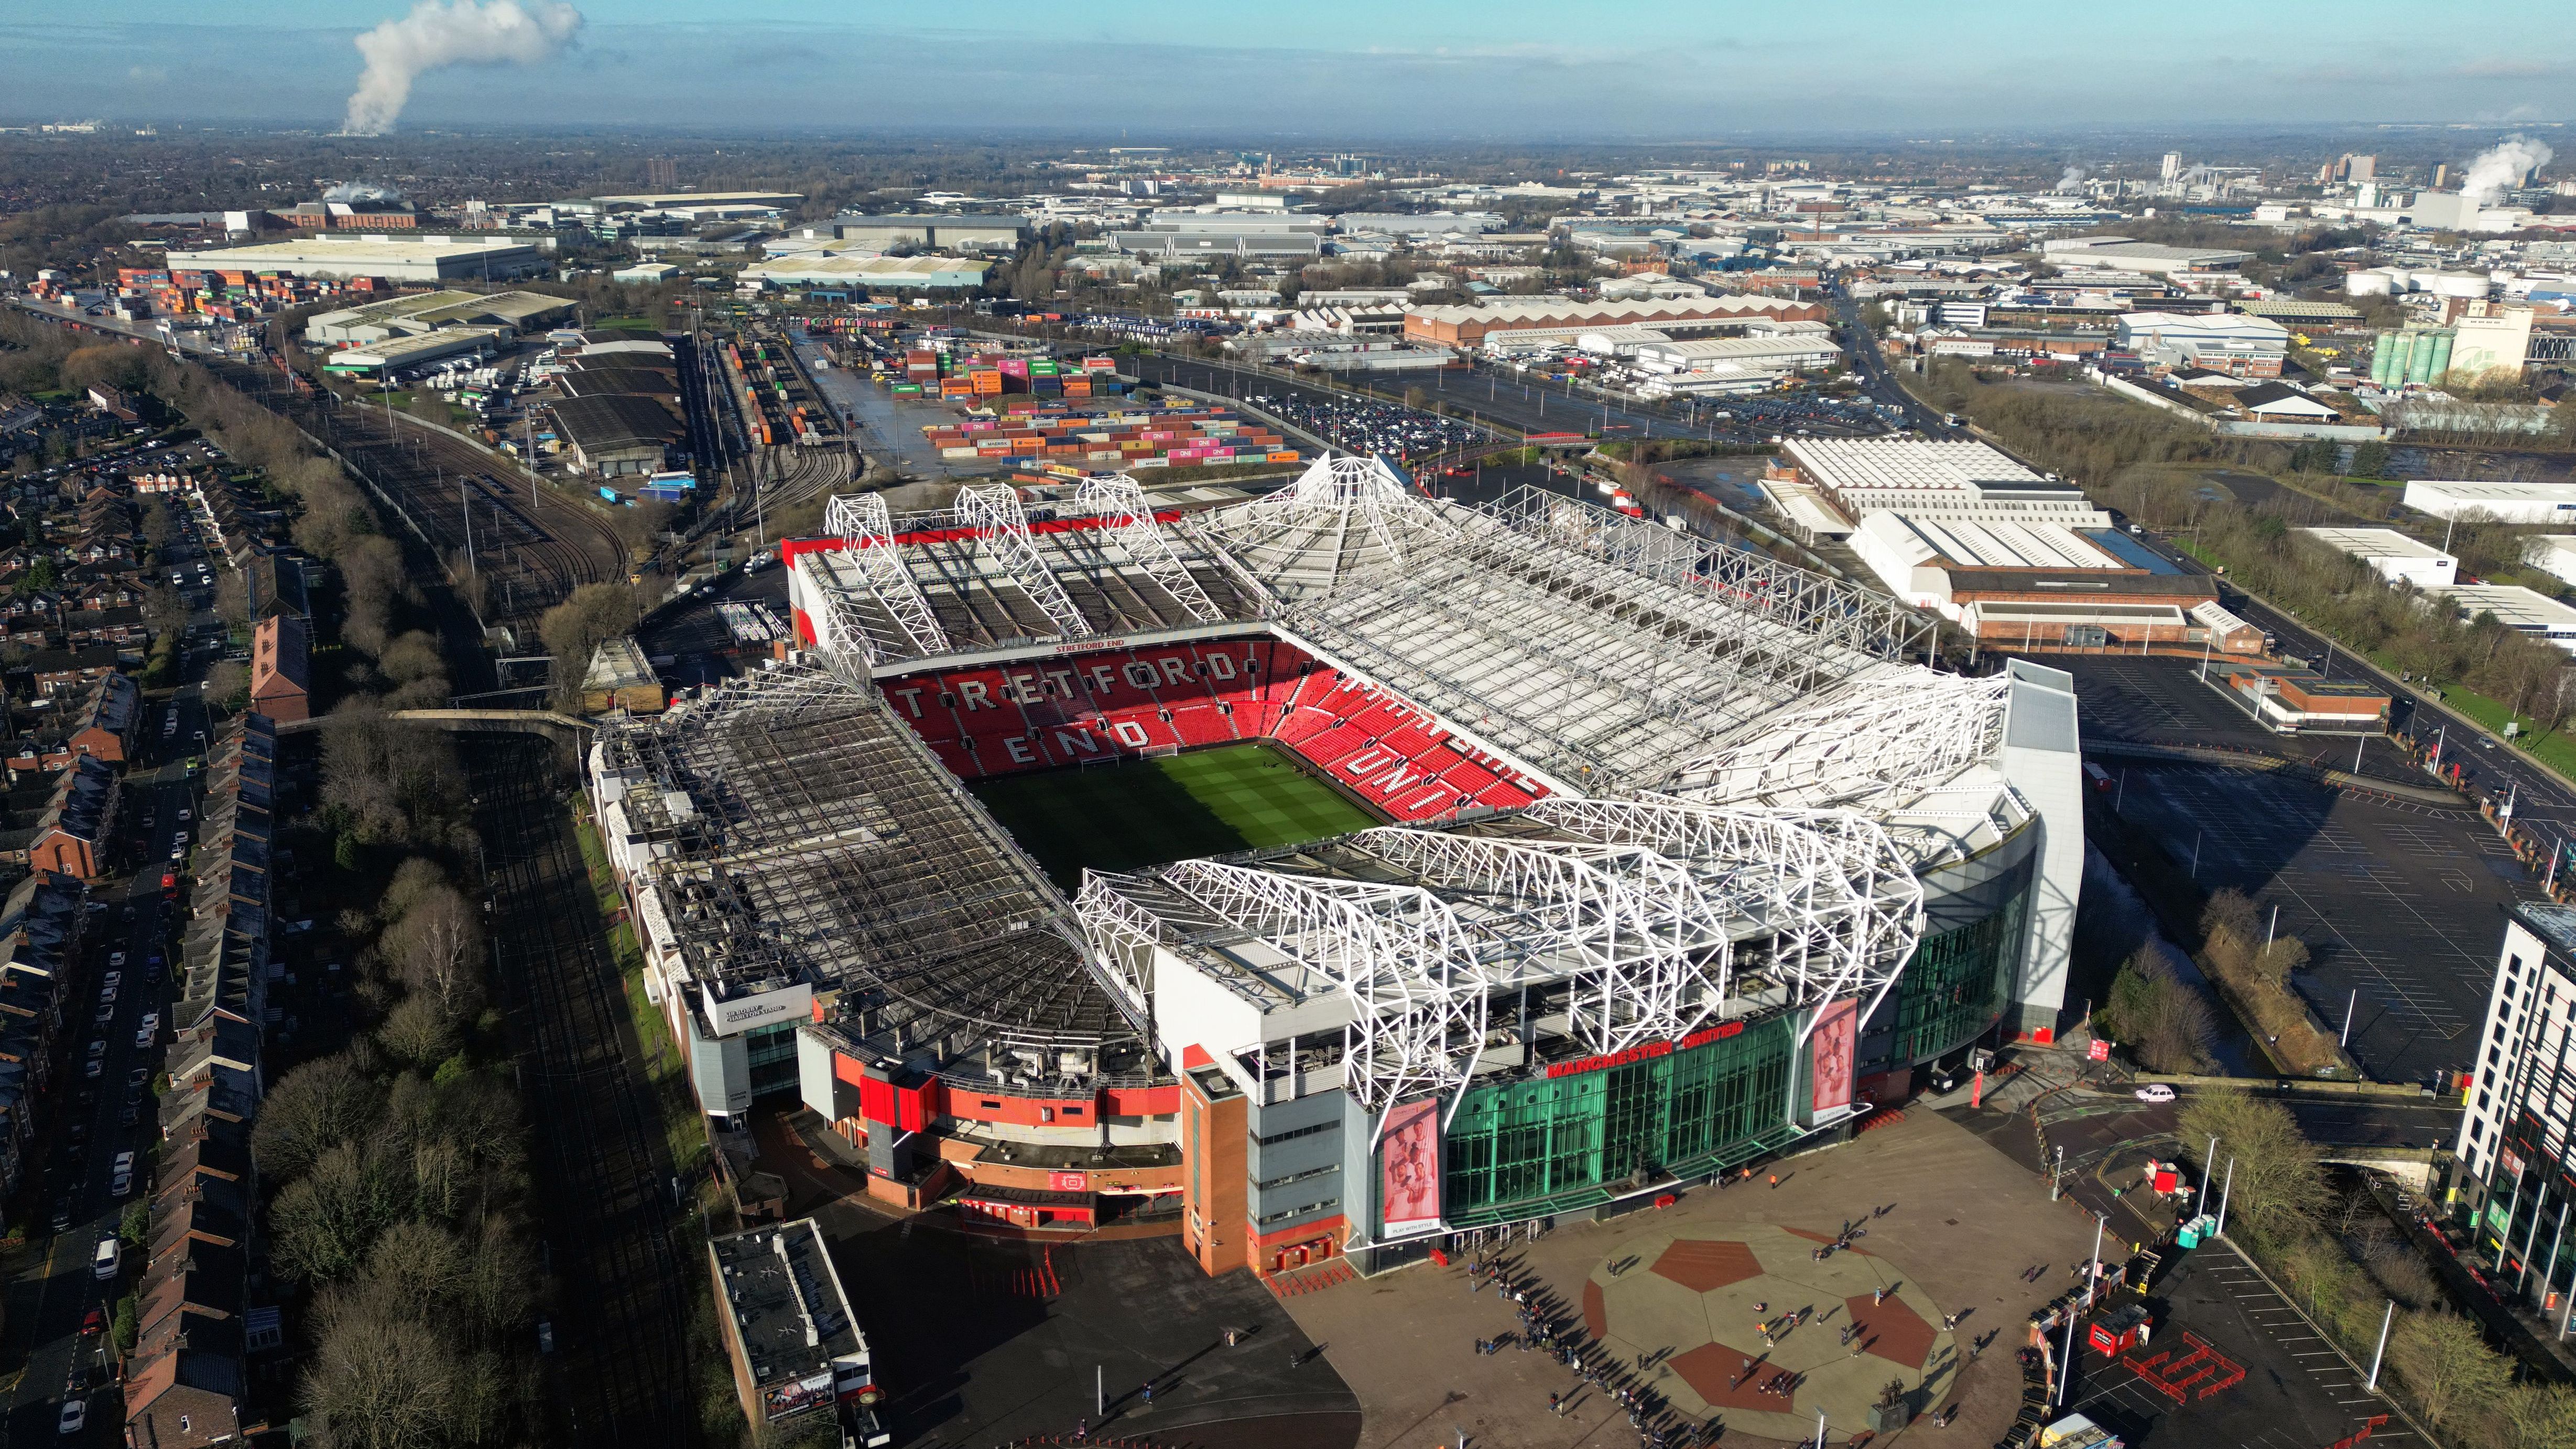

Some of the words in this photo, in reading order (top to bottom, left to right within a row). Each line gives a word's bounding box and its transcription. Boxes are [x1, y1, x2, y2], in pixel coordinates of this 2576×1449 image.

[1056, 642, 1104, 652] STRETFORD
[895, 652, 1238, 718] TRETFORD
[1394, 693, 1419, 712] FERGUSON
[1420, 706, 1437, 722] STAND
[1003, 722, 1149, 764] END
[725, 1010, 760, 1022] CHARLTON
[760, 1005, 782, 1015] STAND
[736, 1006, 759, 1015] BOBBY
[1547, 1041, 1672, 1078] MANCHESTER
[1681, 1021, 1744, 1049] UNITED
[1193, 1095, 1204, 1110] STAND
